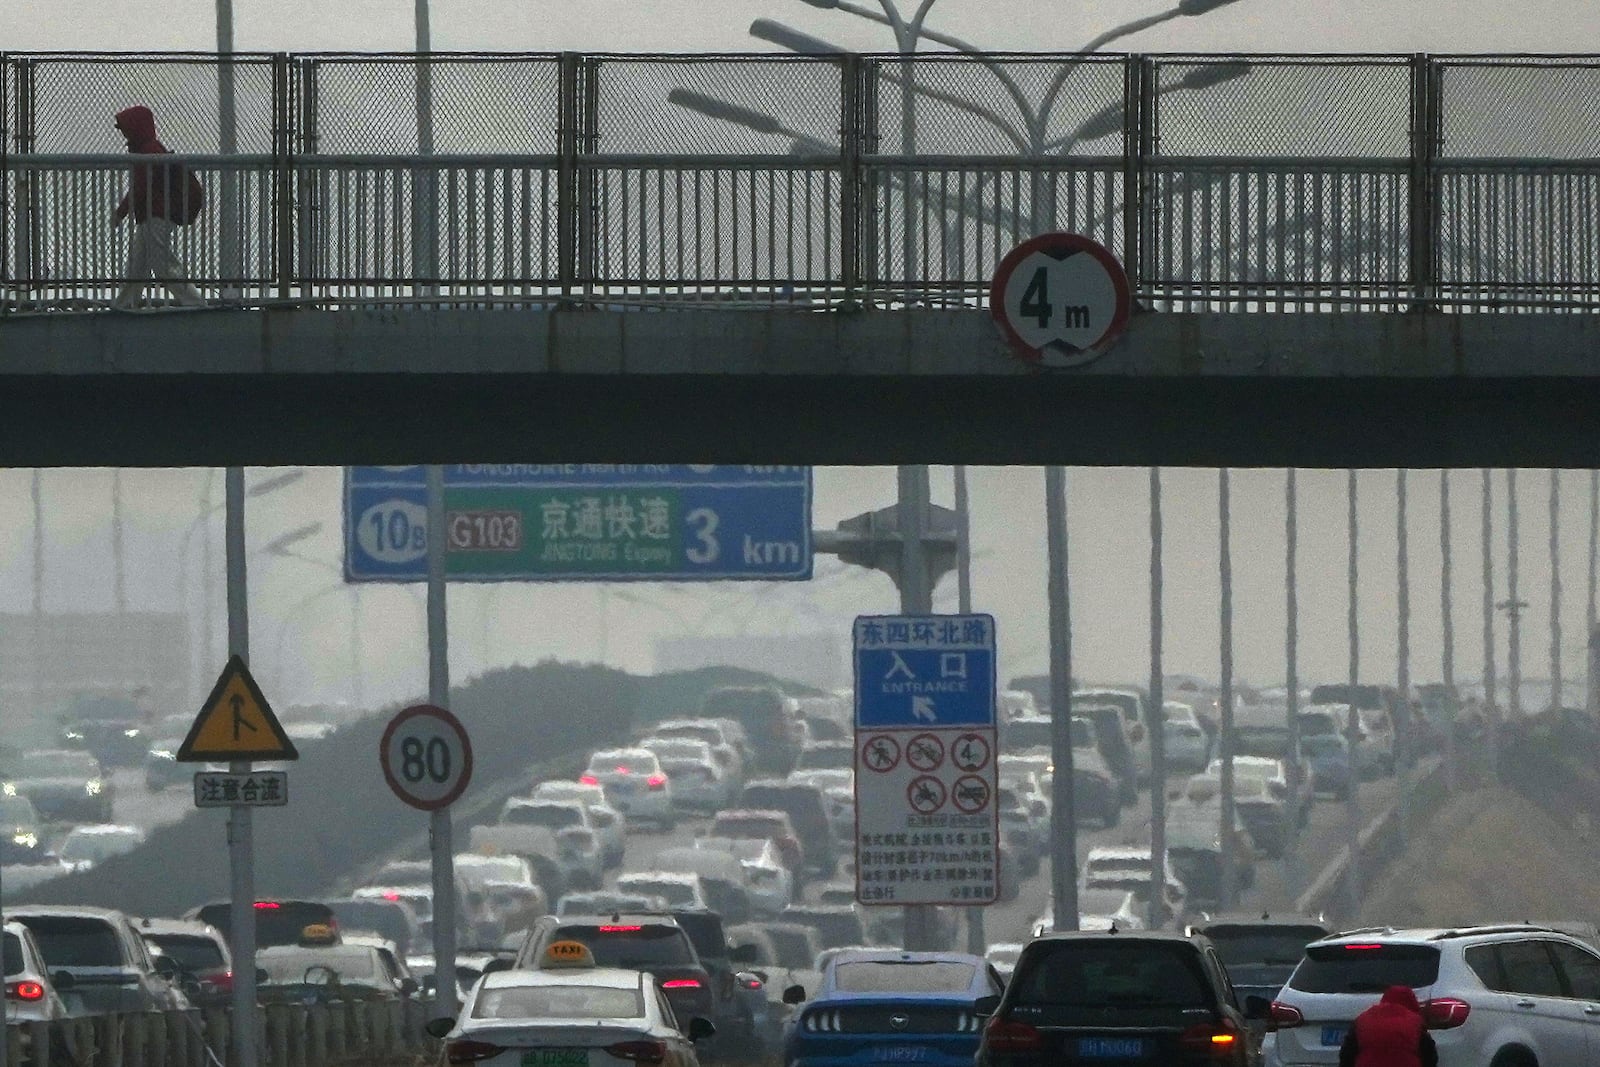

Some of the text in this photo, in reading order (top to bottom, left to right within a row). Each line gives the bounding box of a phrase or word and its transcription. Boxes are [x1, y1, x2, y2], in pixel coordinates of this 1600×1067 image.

[1020, 266, 1091, 328] 4 m
[451, 515, 519, 547] G103
[540, 495, 672, 540] 京通快速
[685, 507, 799, 564] 3 km
[862, 620, 987, 645] 东四环北路
[884, 651, 967, 679] 入口
[881, 681, 969, 693] ENTRANCE
[401, 736, 451, 783] 80
[201, 778, 281, 803] 注意合流
[553, 945, 581, 954] TAXI
